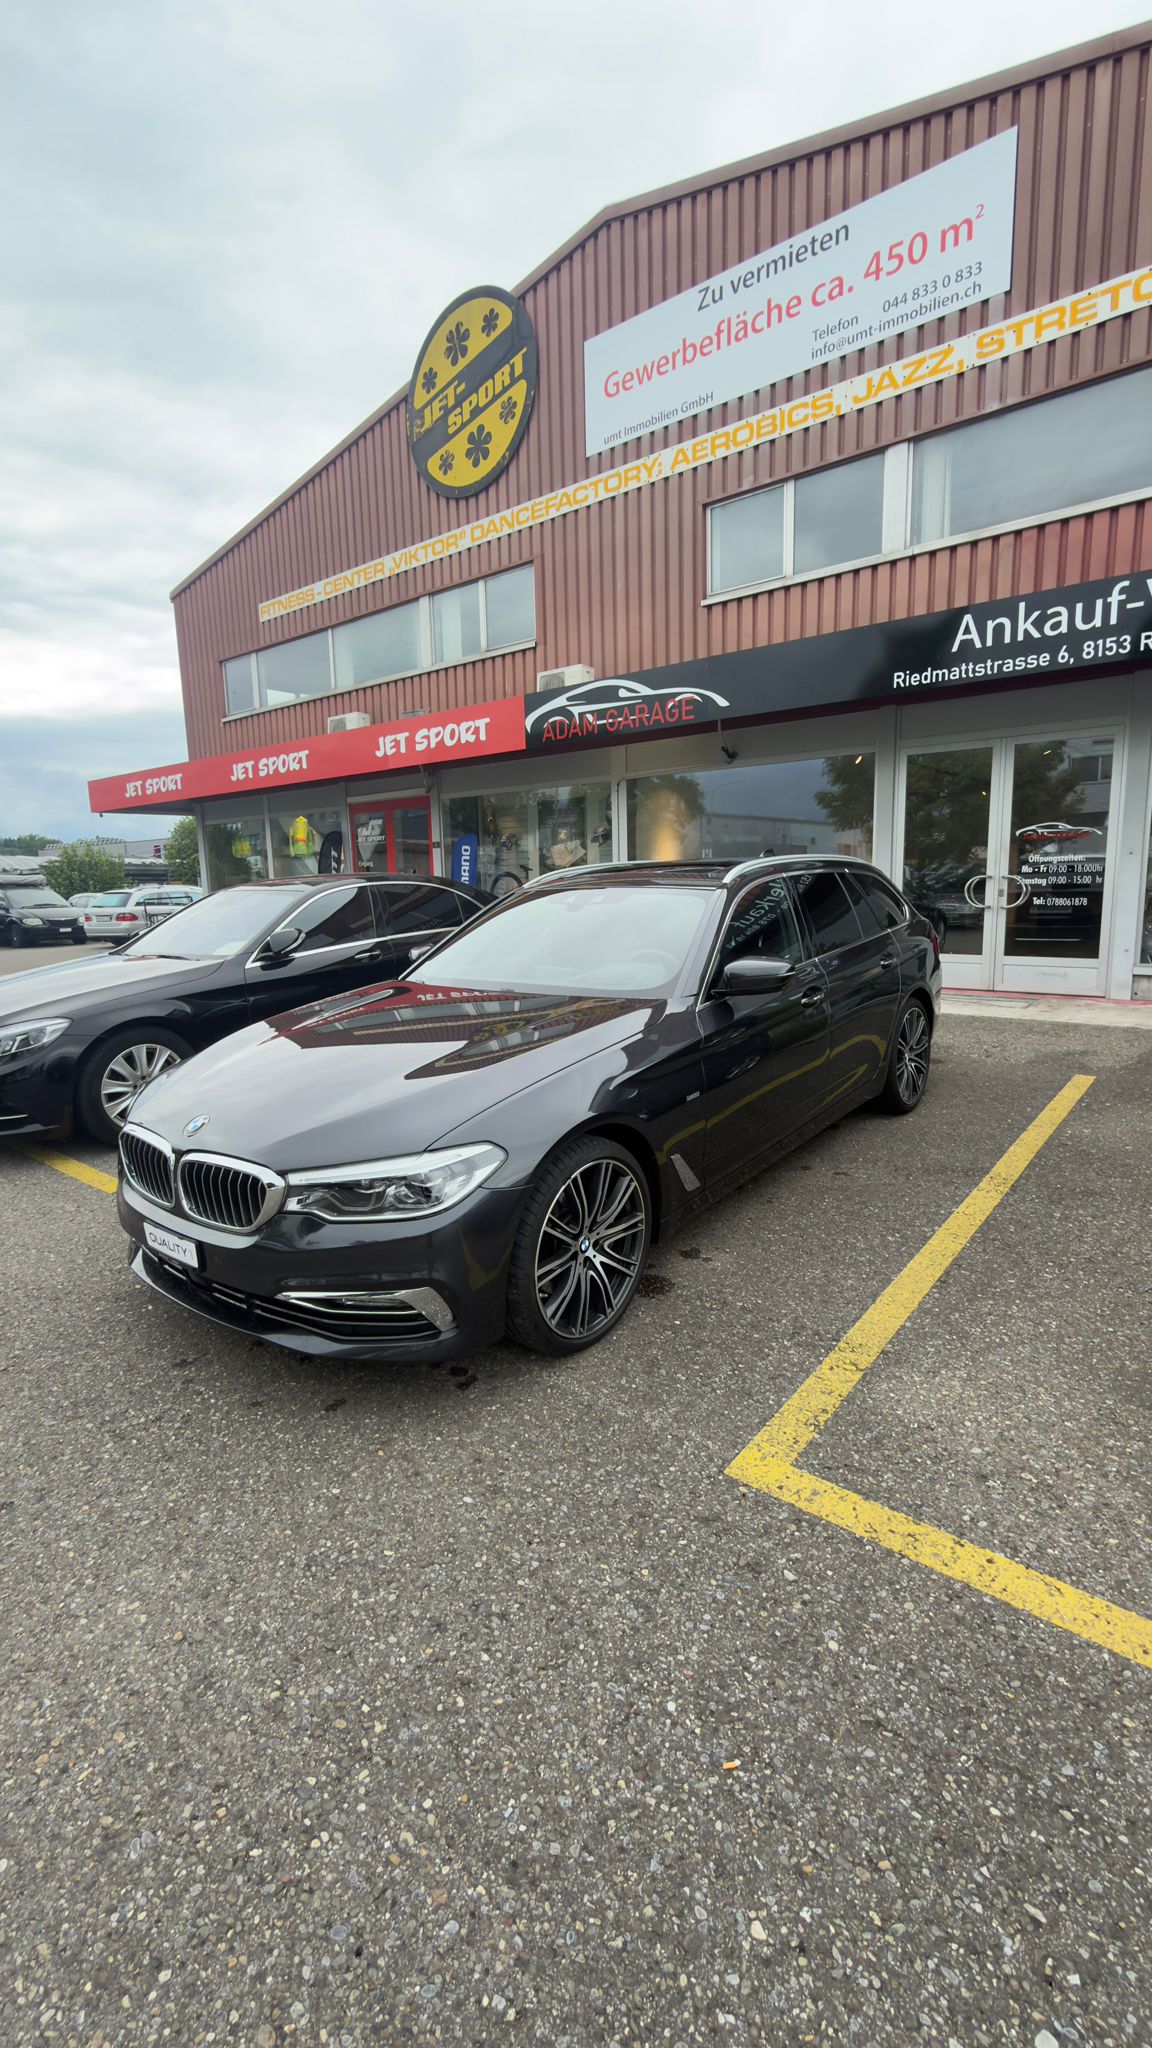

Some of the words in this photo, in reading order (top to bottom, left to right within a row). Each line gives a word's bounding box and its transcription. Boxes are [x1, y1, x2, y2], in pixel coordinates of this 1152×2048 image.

[697, 286, 725, 312] Zu
[730, 223, 851, 295] vermieten
[603, 294, 802, 399] Gewerbefläche
[811, 275, 854, 308] ca.
[863, 231, 928, 282] 450
[811, 281, 982, 360] info@umt-immobilien.ch
[812, 315, 859, 342] Telefon
[882, 292, 908, 313] 044
[912, 280, 938, 301] 833
[942, 274, 951, 288] 0
[955, 261, 983, 283] 833
[447, 347, 528, 435] SPORT
[470, 458, 663, 543] DANCEFACTORY:
[670, 391, 842, 471] AEROBICS,
[851, 344, 965, 406] JAZZ,
[603, 429, 622, 446] umt
[624, 406, 679, 438] Immobilien
[681, 391, 714, 414] GmbH
[893, 650, 1050, 688] Riedmattstrasse
[1057, 645, 1075, 665] 6,
[1082, 635, 1131, 660] 8153
[375, 732, 408, 758] JET
[415, 718, 491, 751] SPORT
[542, 713, 599, 743] ADAM
[606, 697, 695, 732] GARAGE
[125, 781, 142, 798] JET
[145, 773, 183, 795] SPORT
[230, 760, 255, 782] JET
[258, 750, 309, 777] SPORT
[1040, 865, 1048, 873] Fr
[1073, 875, 1092, 884] 15:00
